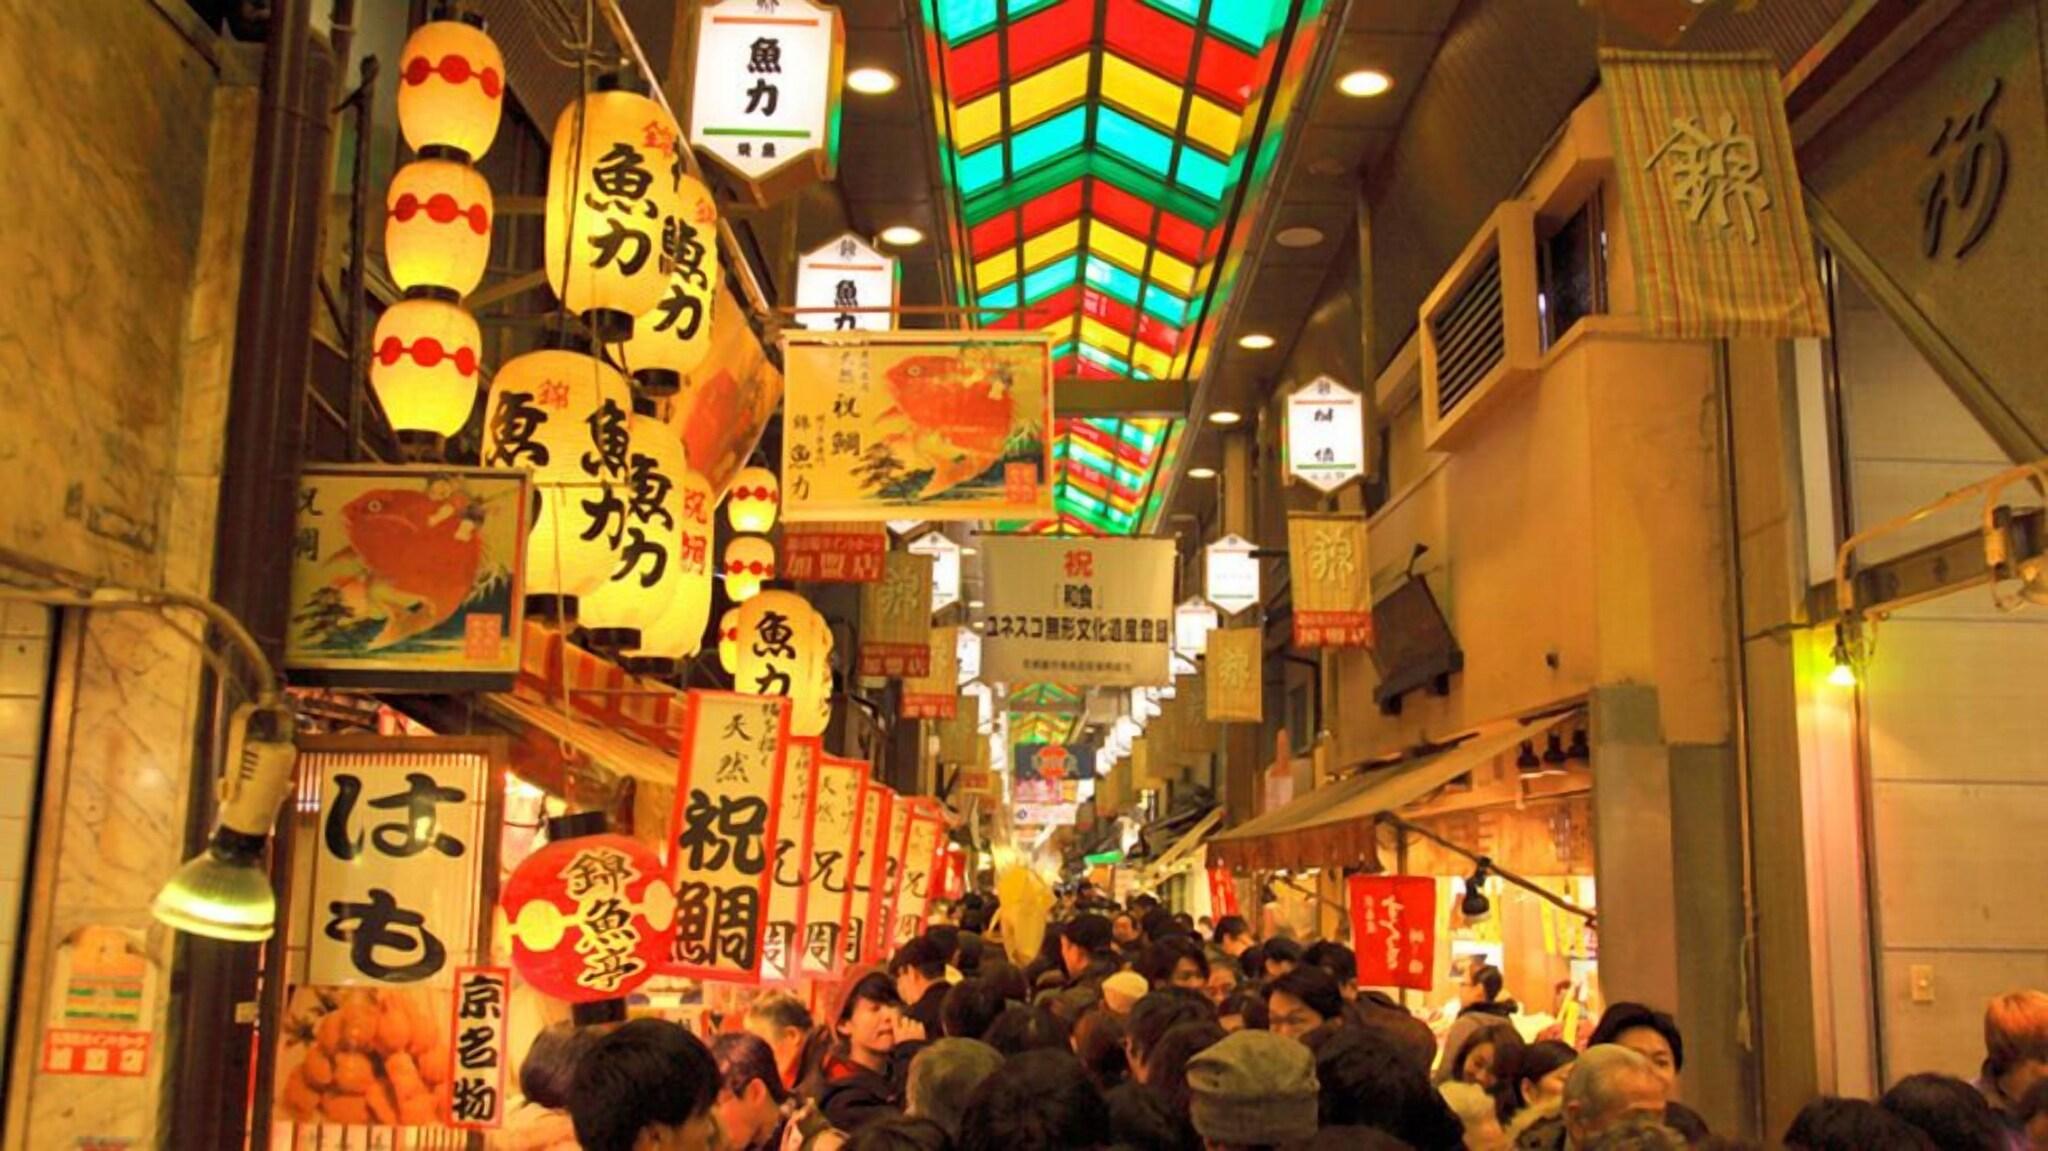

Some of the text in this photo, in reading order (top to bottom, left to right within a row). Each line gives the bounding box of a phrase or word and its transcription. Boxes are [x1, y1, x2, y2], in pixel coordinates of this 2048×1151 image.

[745, 37, 782, 117] 魚力
[584, 142, 659, 277] 魚力
[1063, 549, 1094, 578] 祝
[753, 610, 797, 697] 魚力
[716, 714, 753, 783] 天然
[325, 773, 467, 982] はも
[671, 789, 769, 969] 祝鯛
[455, 975, 505, 1122] 京名物
